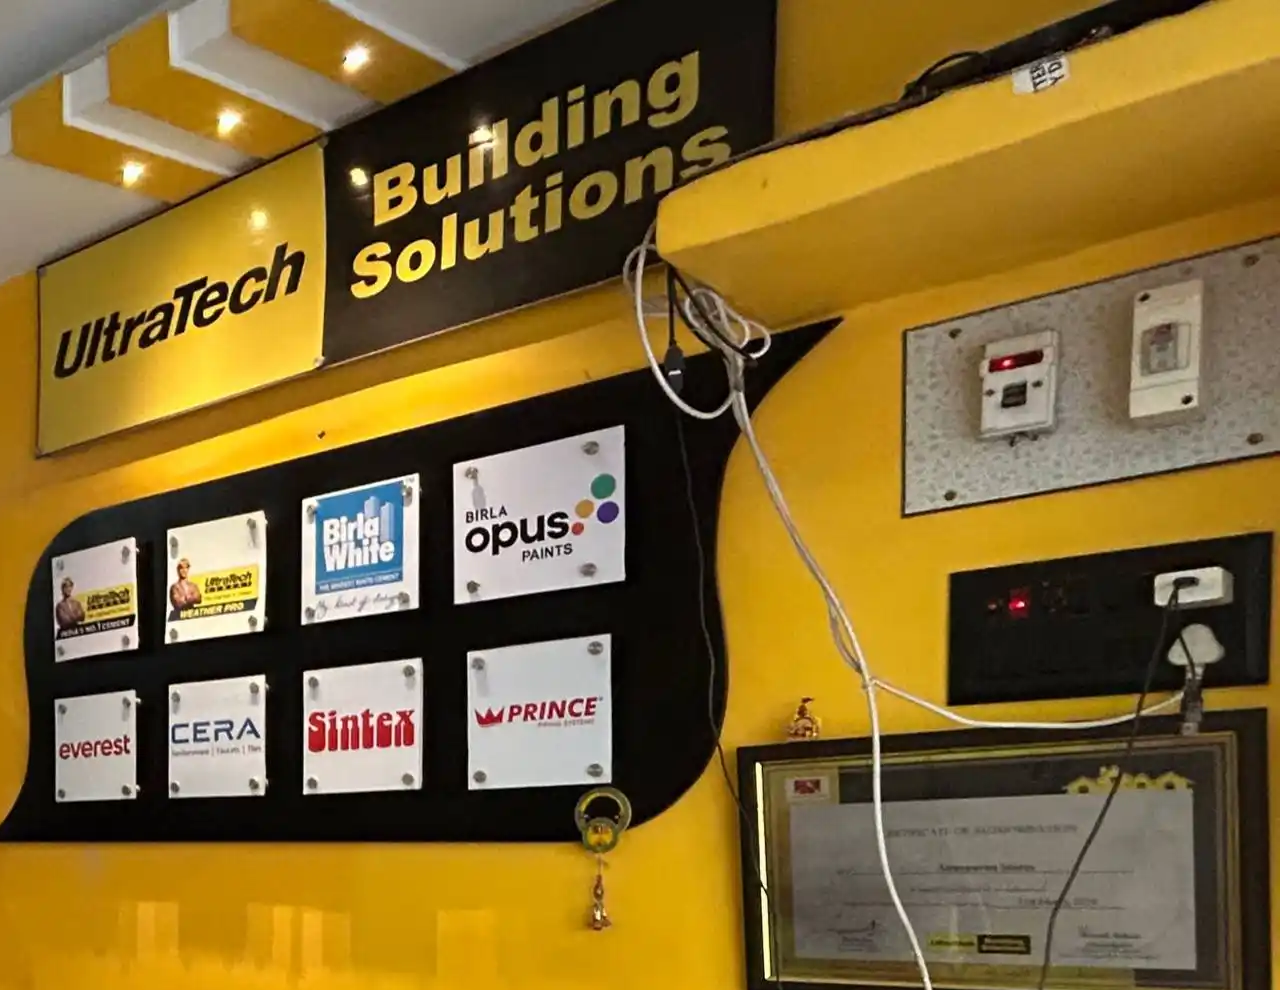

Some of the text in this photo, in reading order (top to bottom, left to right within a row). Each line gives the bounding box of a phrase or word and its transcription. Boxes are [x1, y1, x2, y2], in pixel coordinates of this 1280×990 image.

[373, 50, 701, 227] Building
[350, 124, 732, 299] Solutions
[53, 242, 306, 379] UltraTech
[323, 512, 380, 546] Birla
[465, 505, 508, 523] BIRLA
[465, 511, 570, 556] opus
[324, 536, 395, 572] White
[522, 543, 573, 562] PAINTS
[180, 602, 245, 619] WEATHER PRO
[507, 696, 598, 723] PRINCE
[59, 734, 131, 759] everest
[171, 717, 261, 744] CERA
[308, 709, 415, 753] Sintex
